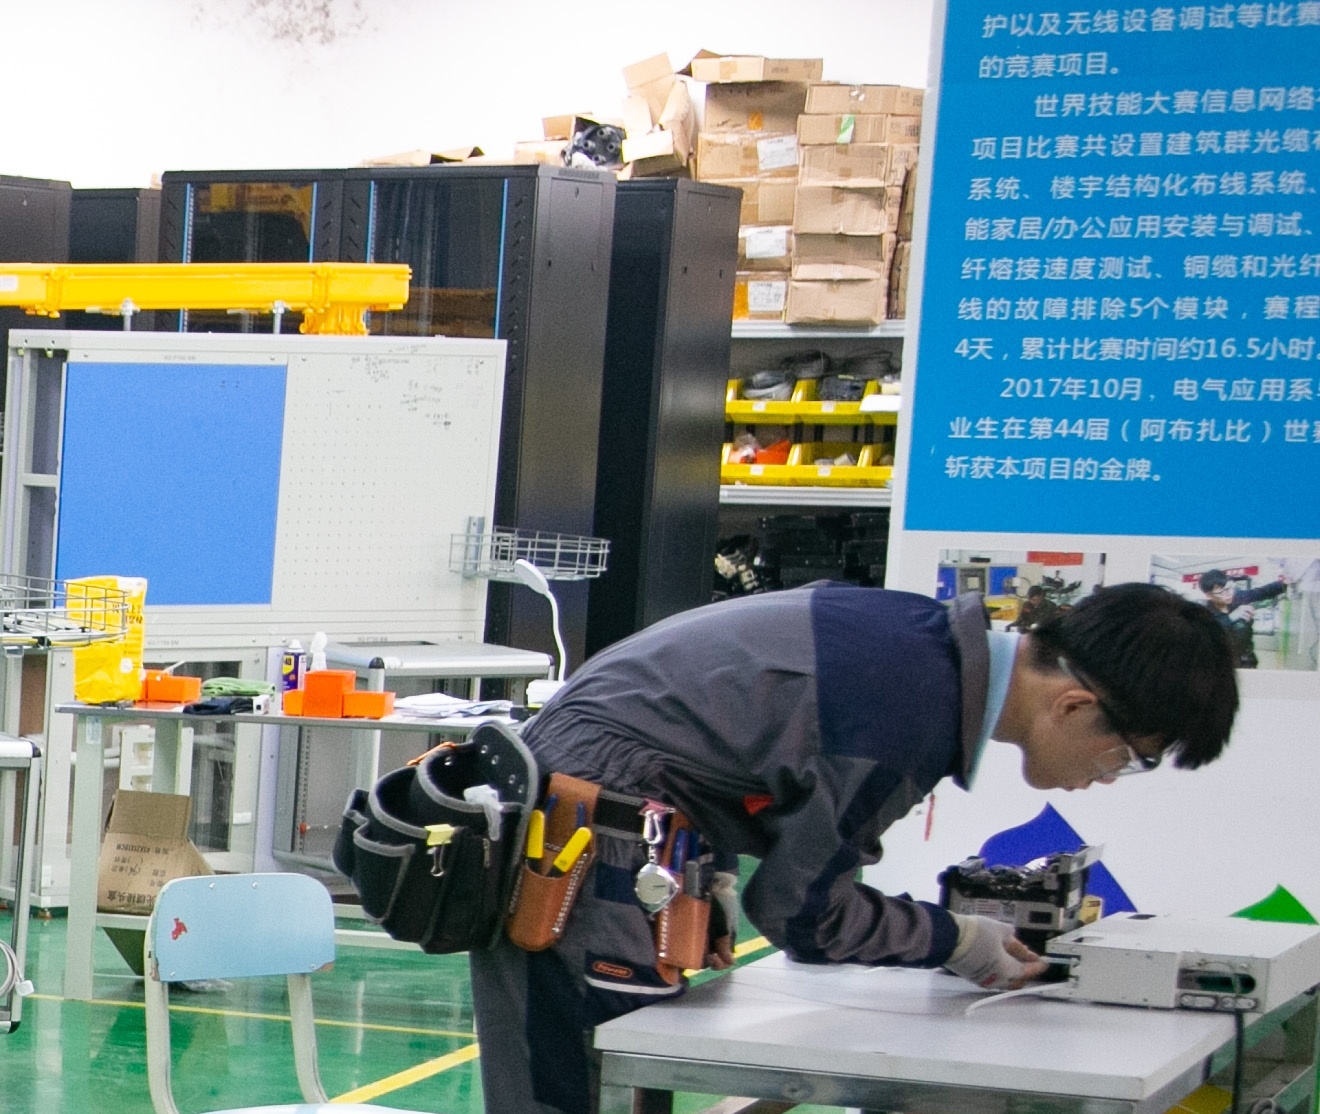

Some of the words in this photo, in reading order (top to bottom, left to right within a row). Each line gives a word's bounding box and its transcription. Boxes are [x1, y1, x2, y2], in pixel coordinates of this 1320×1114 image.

[978, 52, 1119, 79] 的竞赛项目。
[1034, 86, 1320, 118] 世界技能大赛信息网络
[999, 377, 1320, 402] 2017年10月，电气应用系
[944, 455, 1162, 482] 斩获本项目的金牌。
